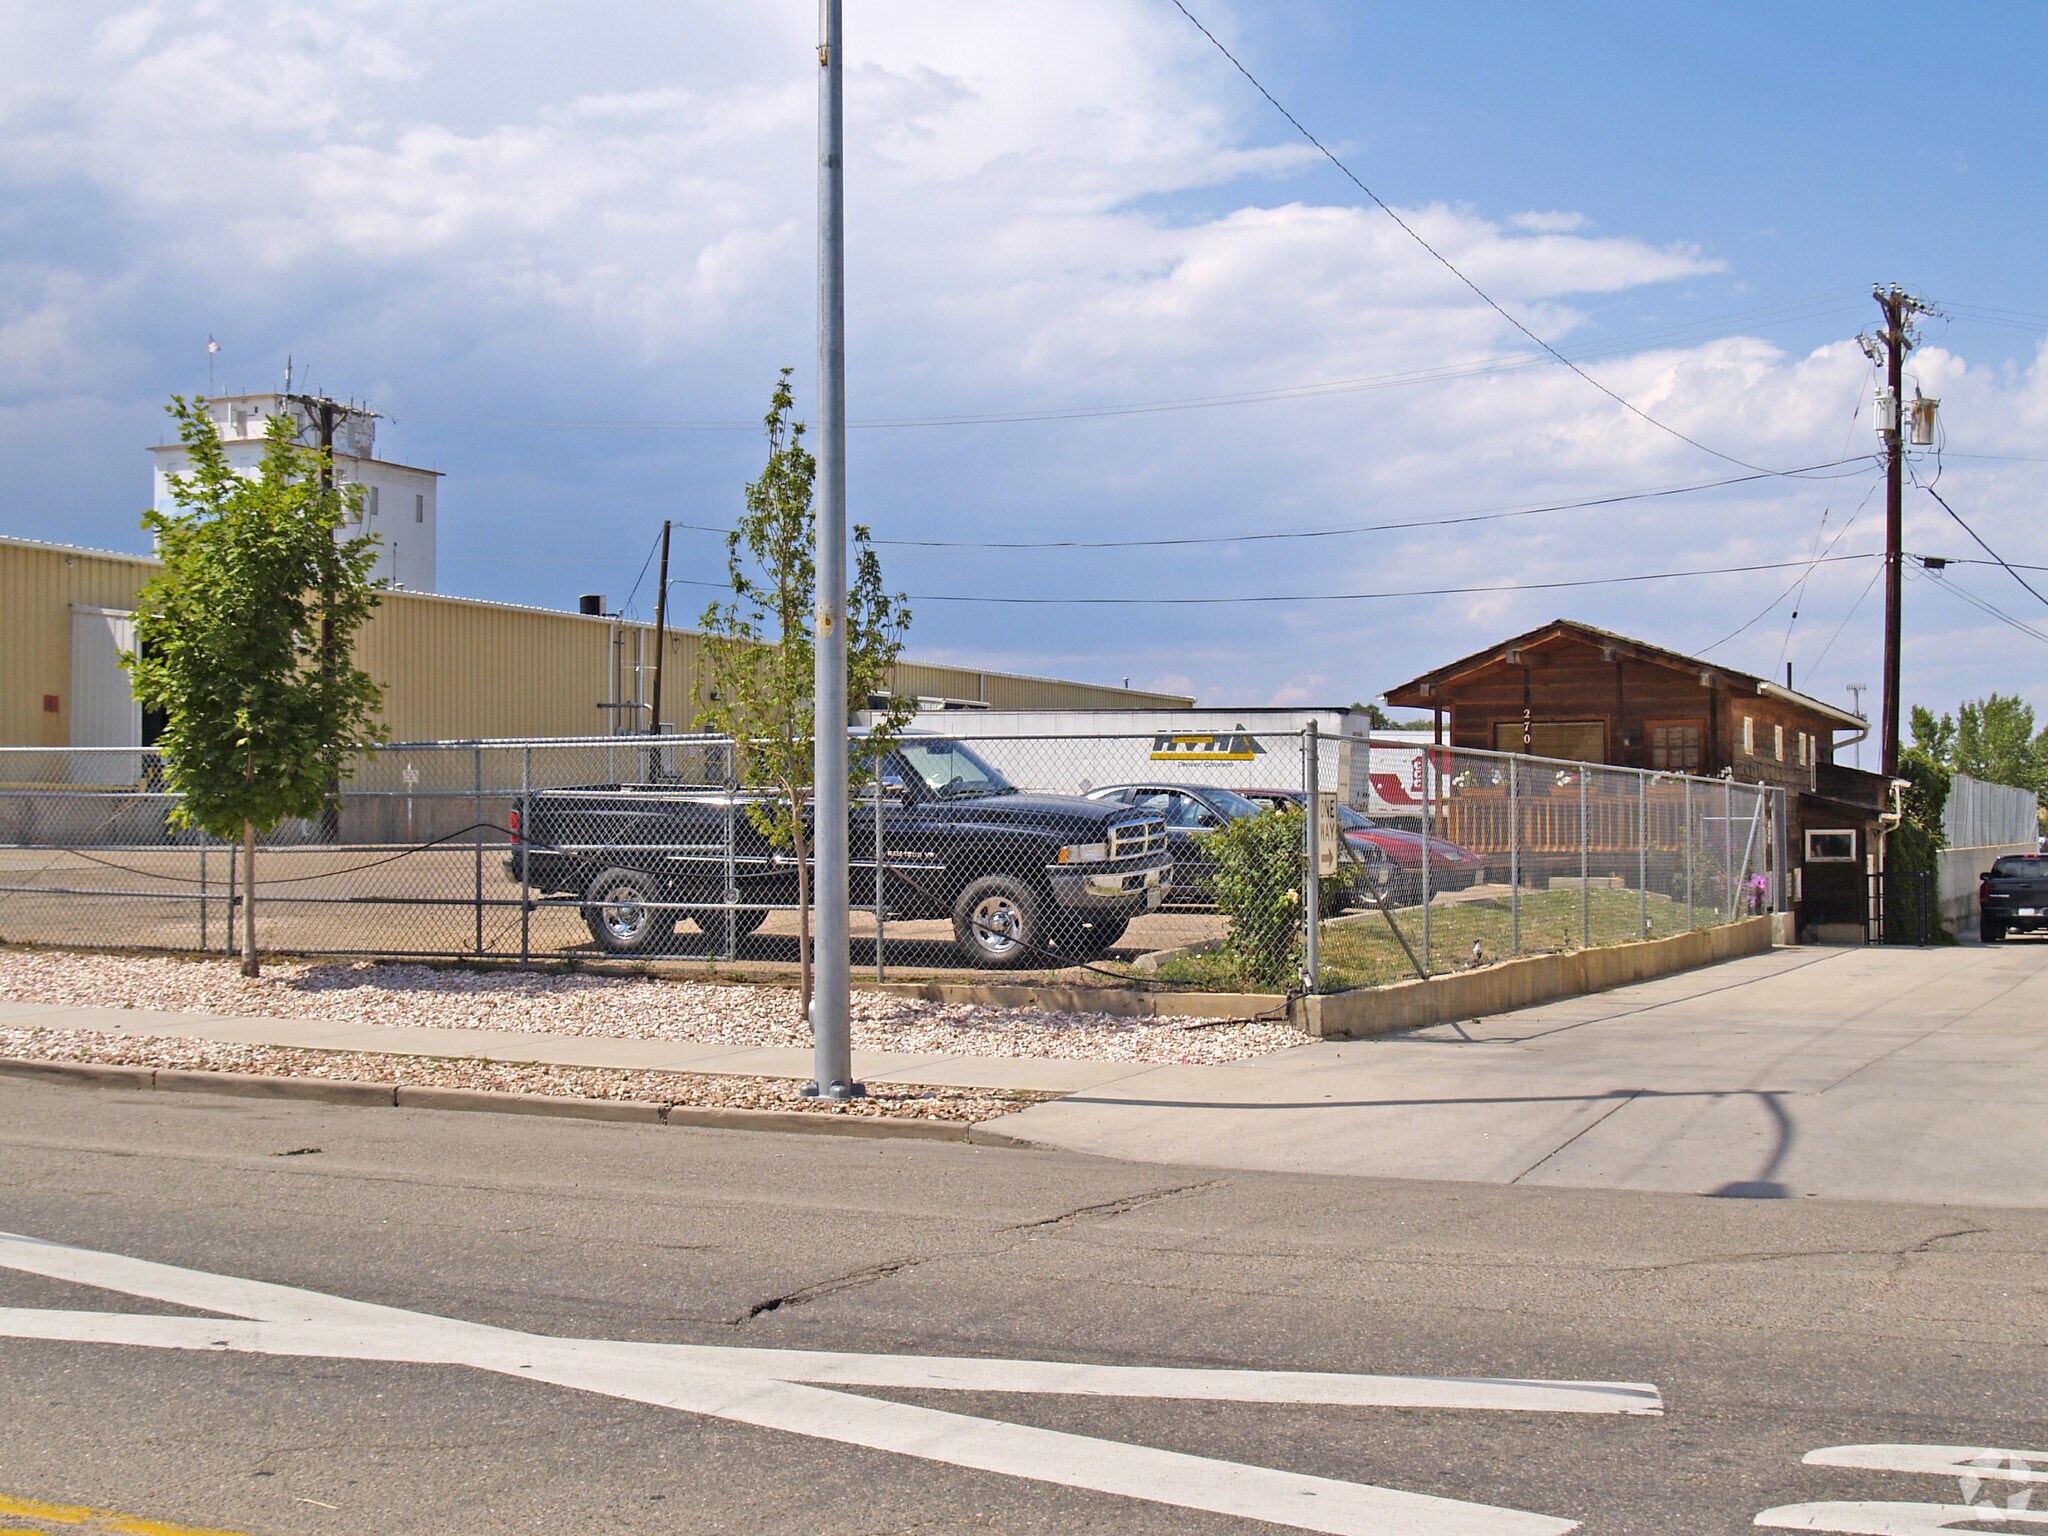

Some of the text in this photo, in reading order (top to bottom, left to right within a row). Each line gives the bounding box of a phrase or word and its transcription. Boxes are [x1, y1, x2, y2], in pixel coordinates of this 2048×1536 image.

[1523, 708, 1531, 744] 270
[1320, 799, 1335, 818] ONE
[1320, 823, 1335, 841] WAY
